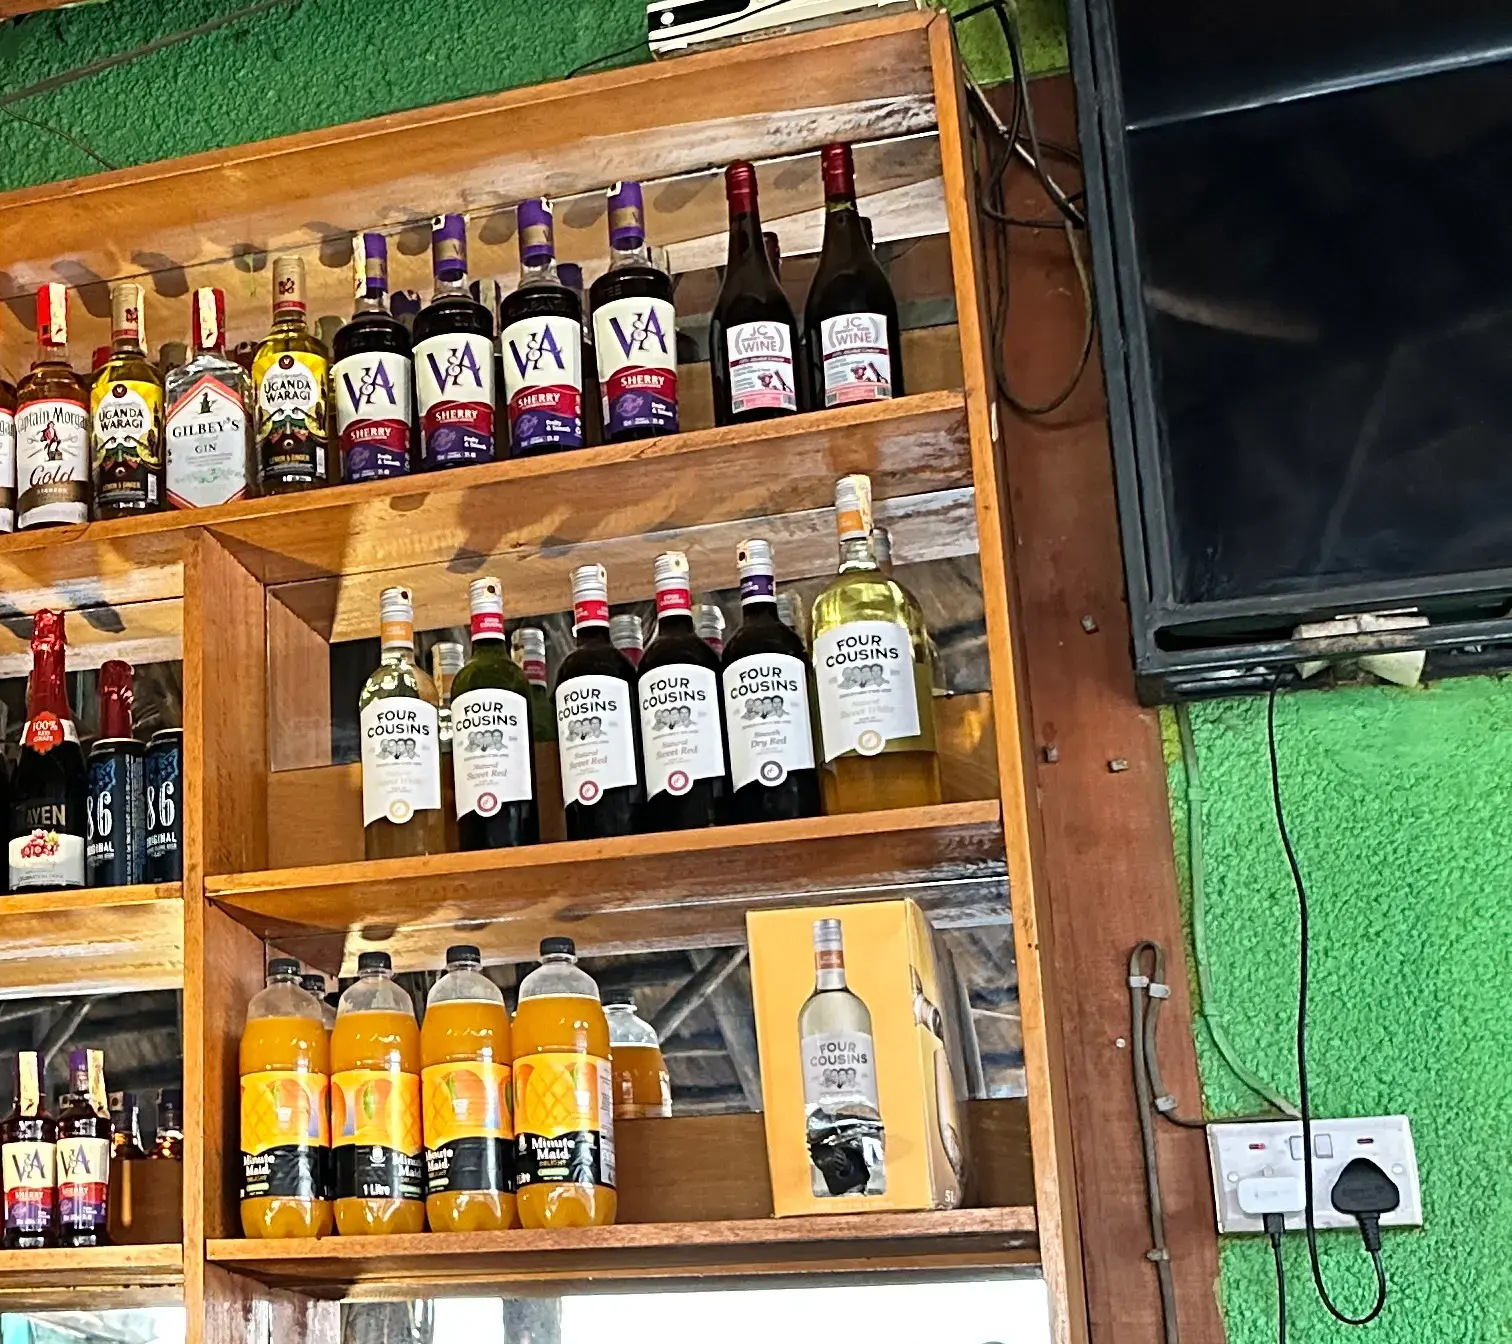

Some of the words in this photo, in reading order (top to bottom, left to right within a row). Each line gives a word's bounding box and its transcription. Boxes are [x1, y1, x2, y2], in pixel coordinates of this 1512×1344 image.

[609, 305, 668, 361] V&A
[835, 331, 874, 346] WINE
[508, 323, 566, 381] V&A
[741, 341, 777, 354] WINE
[426, 340, 484, 396] V&A
[264, 379, 312, 395] UGANDA
[342, 358, 398, 415] V&A
[620, 374, 665, 386] SHERRY
[266, 390, 311, 405] WARAGI
[518, 393, 561, 408] SHERRY
[99, 408, 144, 423] UGANDA
[435, 409, 479, 422] SHERRY
[100, 416, 143, 432] WARAGI
[172, 416, 240, 439] GILBEY'S
[350, 427, 392, 440] SHERRY
[194, 443, 217, 454] GIN
[29, 465, 75, 486] Gold
[836, 634, 882, 652] FOUR
[825, 647, 900, 668] COUSINS
[738, 666, 783, 684] FOUR
[649, 677, 690, 695] FOUR
[730, 679, 799, 700] COUSINS
[564, 688, 601, 705] FOUR
[642, 690, 707, 711] COUSINS
[464, 701, 504, 716] FOUR
[558, 700, 618, 722] COUSINS
[376, 710, 417, 725] FOUR
[456, 715, 518, 731] COUSINS
[33, 720, 59, 732] 100%
[367, 723, 431, 739] COUSINS
[680, 745, 698, 755] Red
[750, 738, 768, 749] Dry
[769, 736, 787, 745] Red
[591, 756, 608, 765] Red
[491, 768, 508, 777] Red
[146, 780, 176, 831] 86
[819, 1042, 857, 1054] FOUR
[810, 1053, 868, 1067] COUSINS
[532, 1137, 575, 1150] Minute
[537, 1149, 569, 1160] Maid
[944, 1189, 956, 1203] 5L
